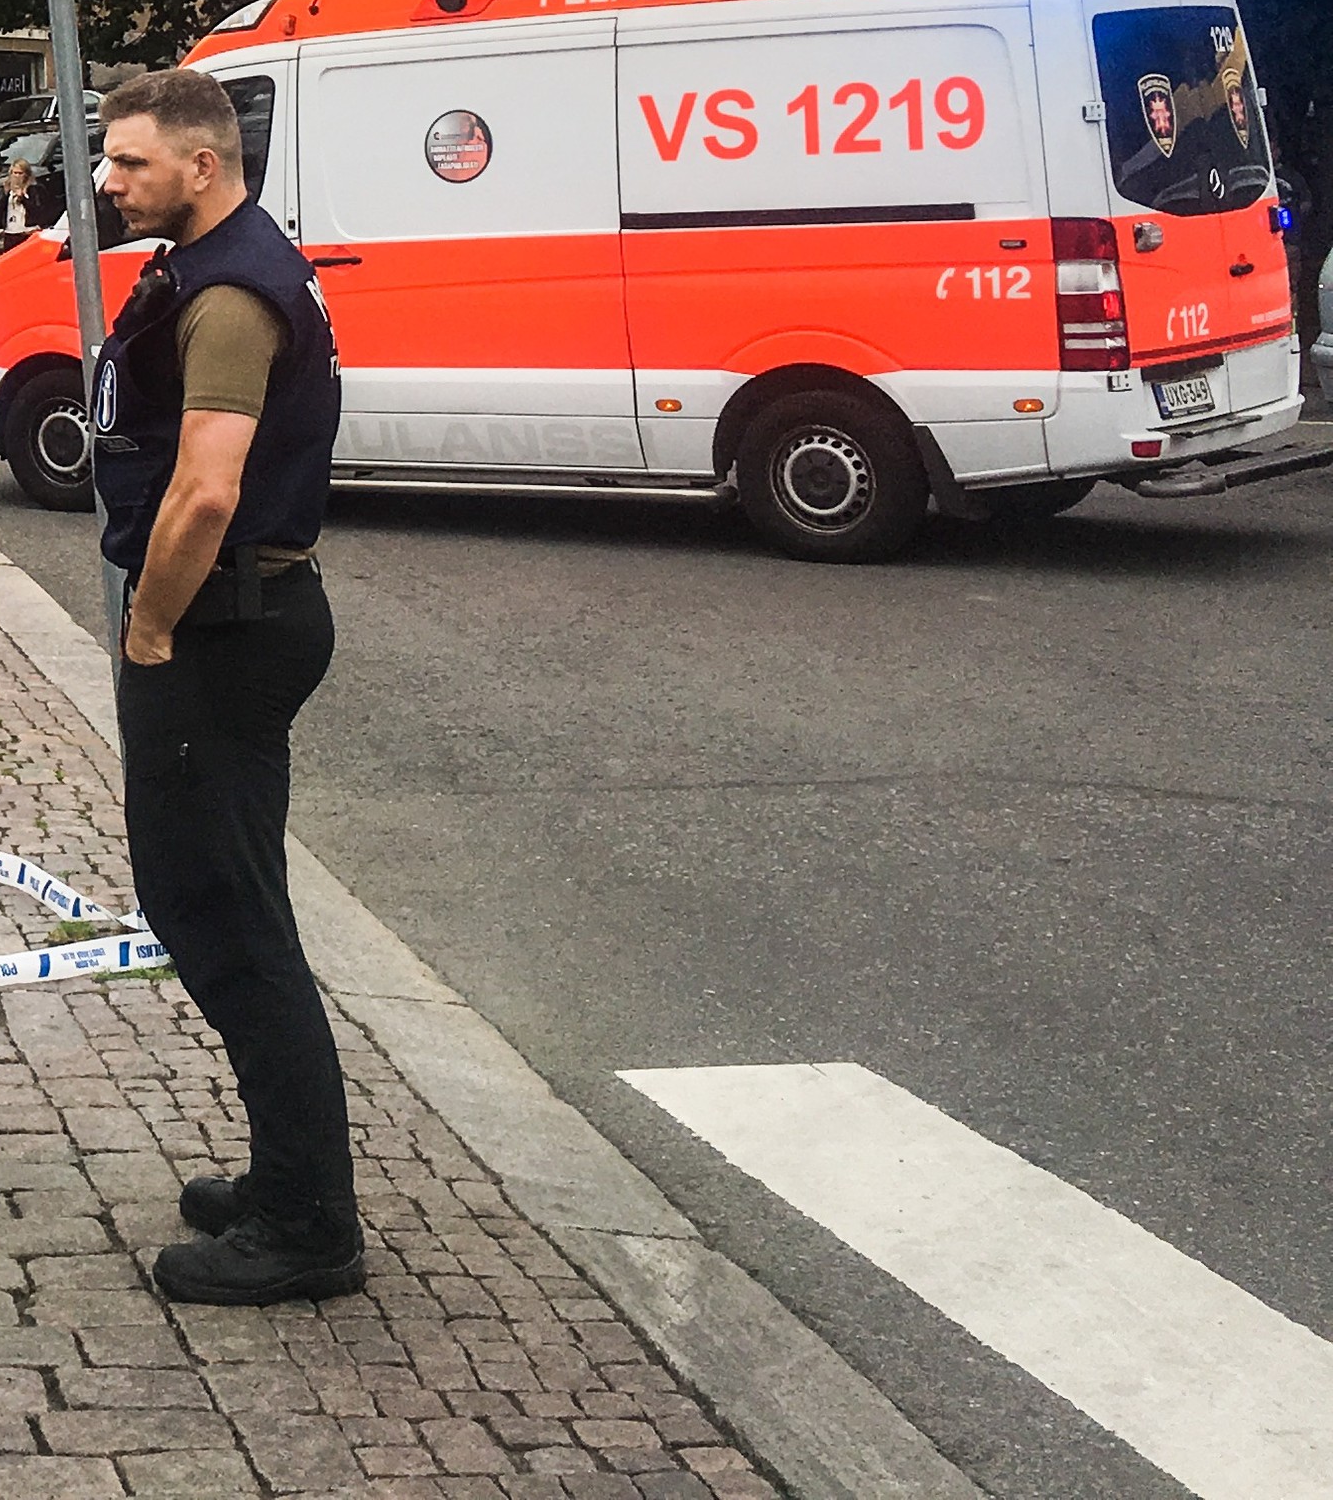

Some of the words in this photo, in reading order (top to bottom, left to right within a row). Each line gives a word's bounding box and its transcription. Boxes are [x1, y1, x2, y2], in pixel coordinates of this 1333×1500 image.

[1210, 26, 1234, 52] 1219
[637, 88, 759, 162] VS
[786, 76, 985, 156] 1219
[965, 265, 1032, 300] 112
[1179, 302, 1210, 339] 112
[1165, 380, 1209, 408] UXG-349
[336, 419, 659, 466] ULANSSI
